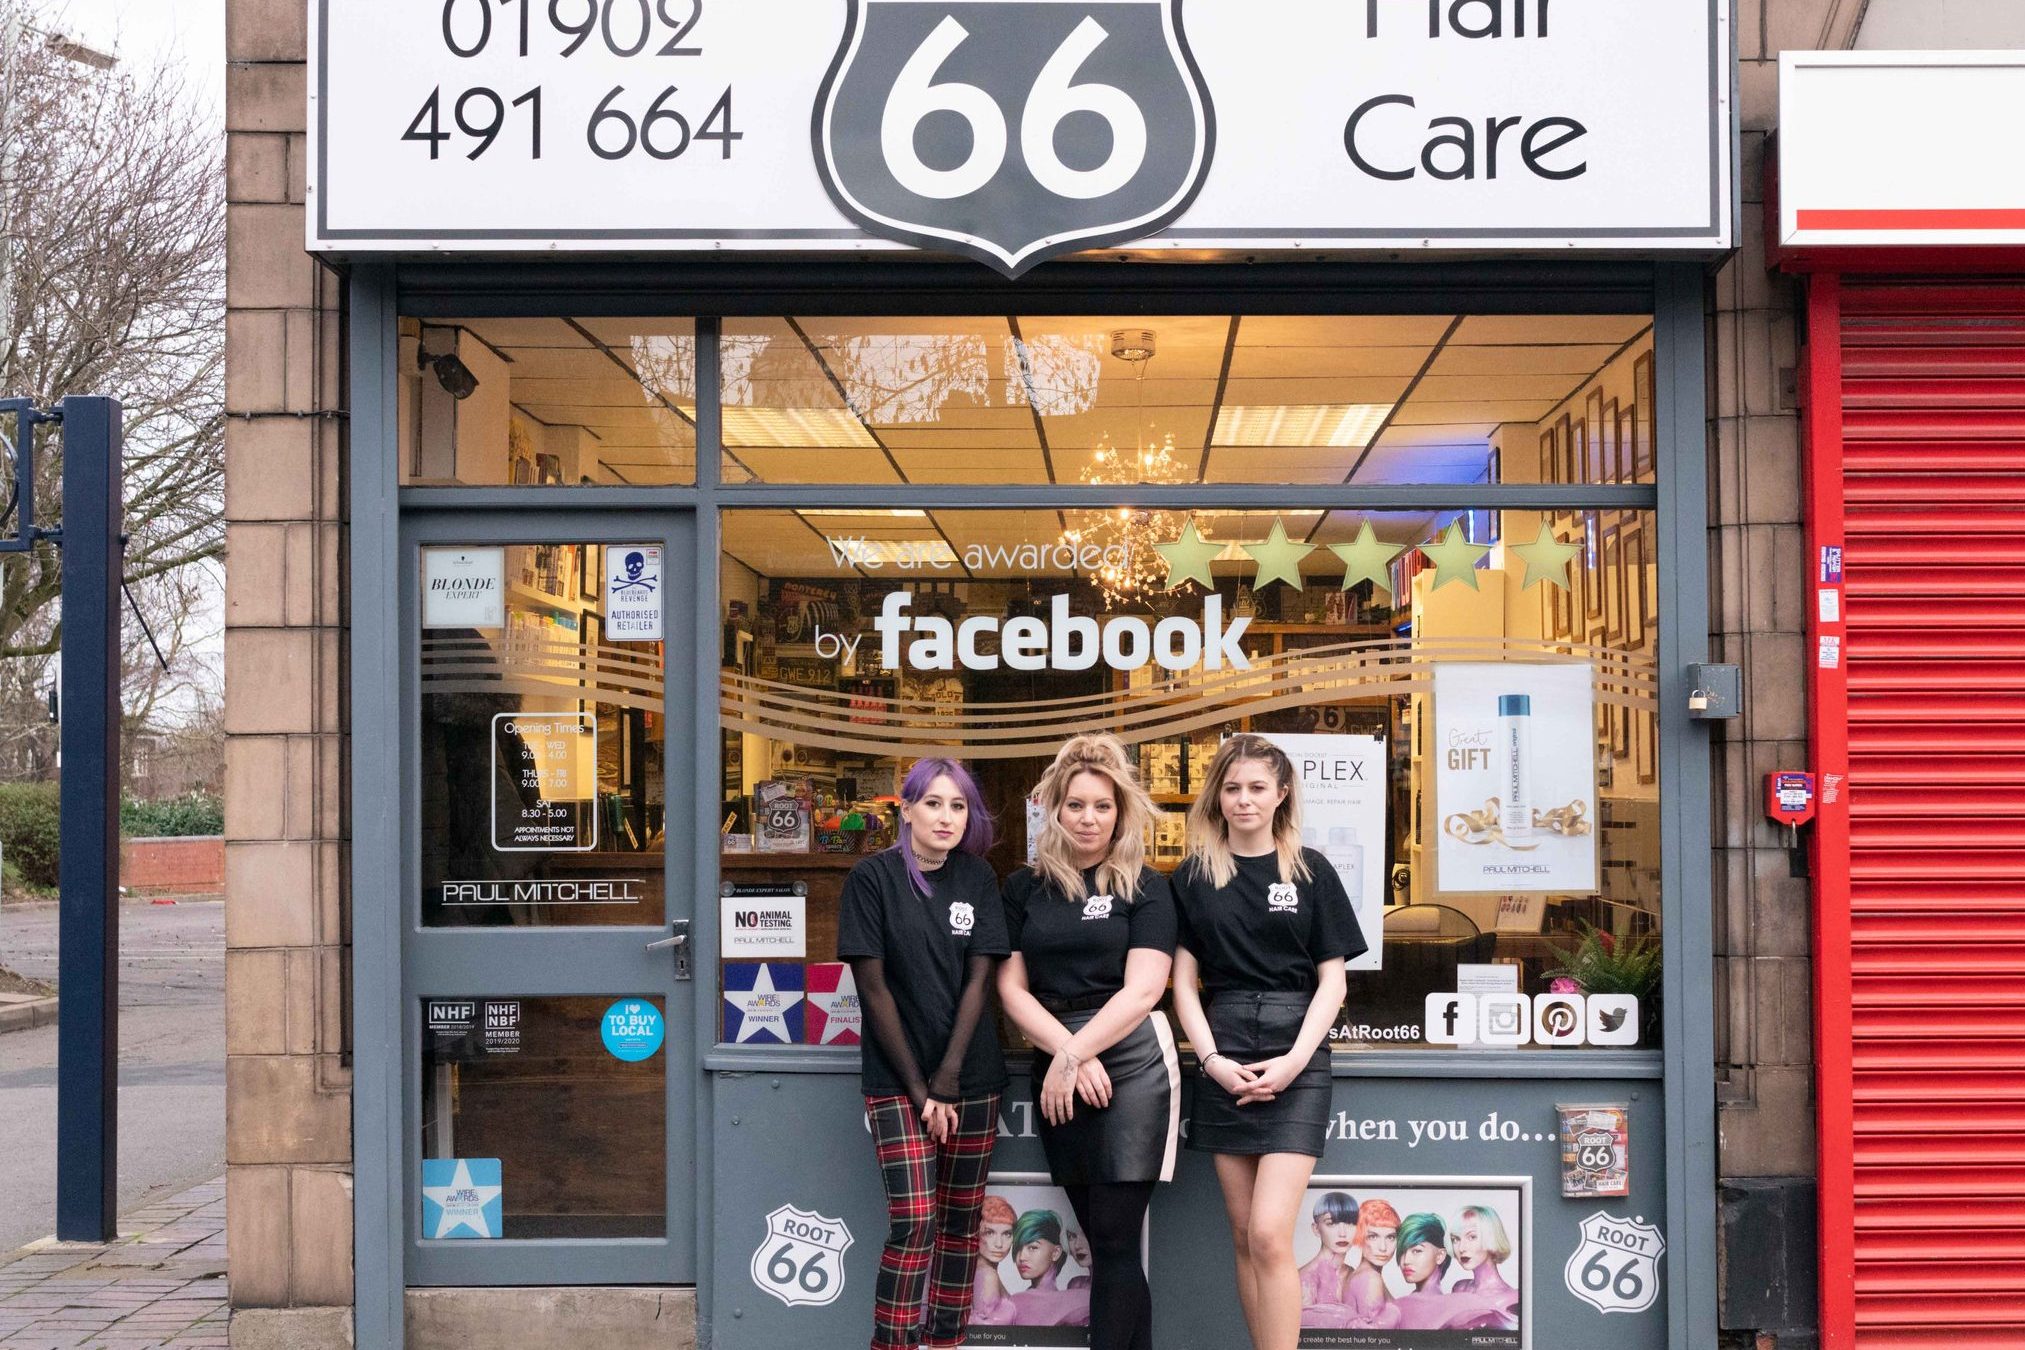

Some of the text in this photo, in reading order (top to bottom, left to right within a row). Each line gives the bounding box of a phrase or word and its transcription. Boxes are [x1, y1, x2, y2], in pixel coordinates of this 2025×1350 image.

[442, 0, 703, 58] 01902
[881, 14, 1147, 199] 66
[401, 84, 743, 161] 491 664
[1343, 94, 1588, 181] Care
[825, 535, 1130, 569] We are awarded
[431, 577, 497, 590] BLONDE
[446, 591, 482, 599] EXPERT
[612, 610, 658, 619] AUTHORISED
[617, 622, 653, 630] RETAILER
[815, 591, 1255, 671] by facebook
[780, 667, 831, 683] GWE 912
[504, 722, 585, 736] Opening Times
[1449, 728, 1493, 747] Great
[1448, 748, 1491, 770] GIFT
[1303, 760, 1363, 780] PLEX
[521, 809, 540, 817] 8.30
[548, 809, 567, 817] 5.00
[772, 811, 795, 827] 66
[443, 883, 638, 901] PAUL MITCHELL
[1274, 891, 1293, 902] 66
[1089, 903, 1107, 912] 66
[735, 911, 792, 927] NO ANIMAL
[955, 912, 971, 925] 66
[433, 1006, 471, 1019] NHF
[488, 1005, 517, 1015] NHF
[625, 1005, 628, 1014] I
[488, 1016, 517, 1026] NBF
[608, 1015, 656, 1025] TO BUY
[612, 1025, 654, 1036] LOCAL
[1408, 1119, 1469, 1148] you
[1582, 1146, 1610, 1166] 66
[783, 1218, 835, 1245] ROOT
[1597, 1225, 1650, 1252] ROOT
[767, 1242, 829, 1294] 66
[1581, 1248, 1644, 1301] 66
